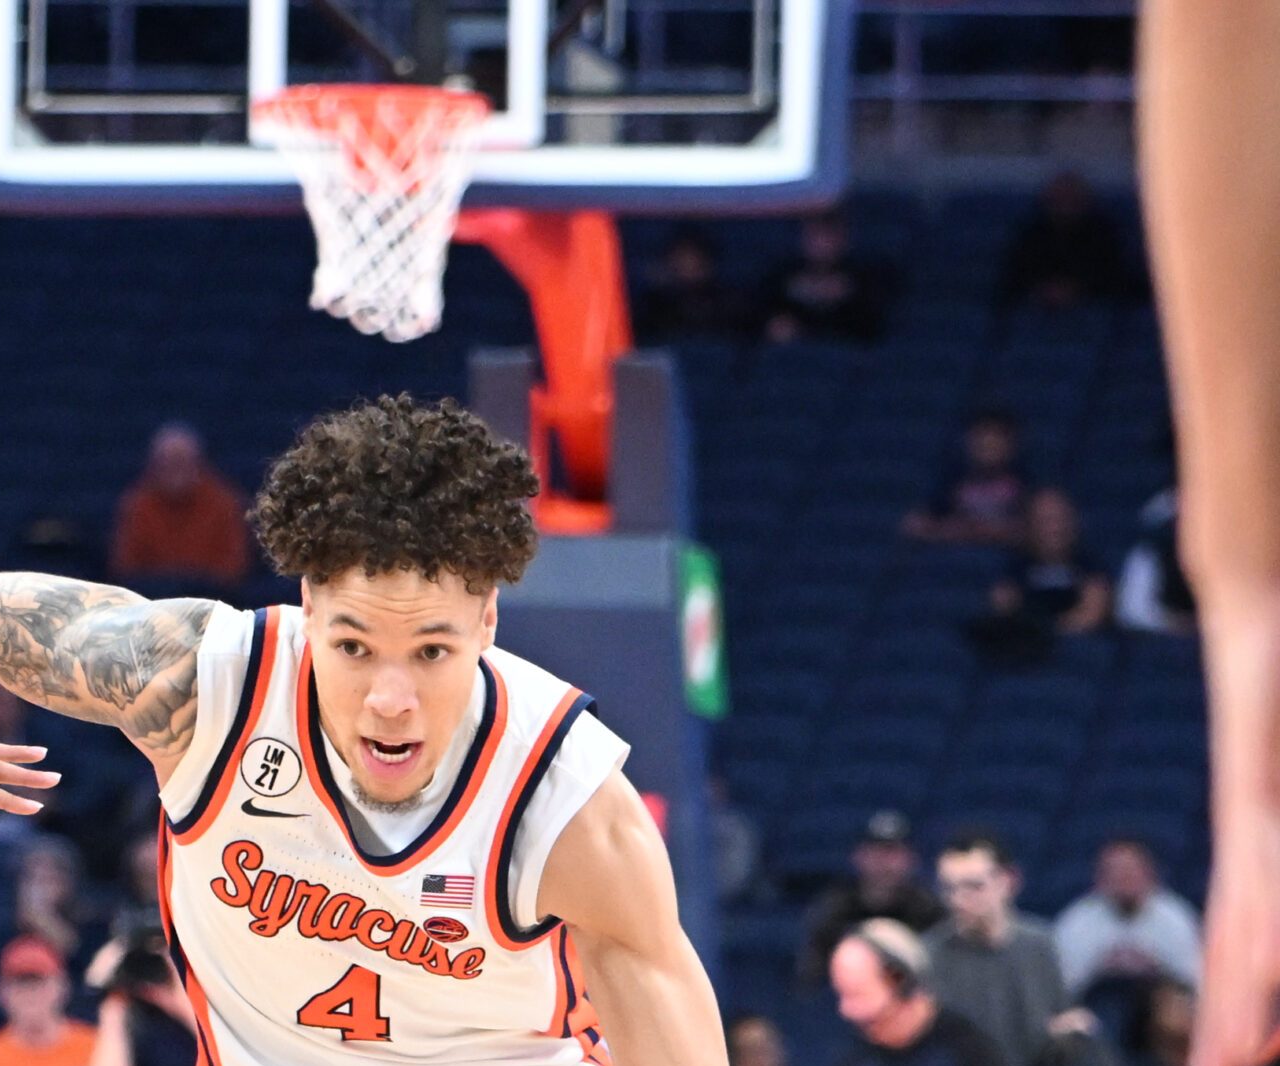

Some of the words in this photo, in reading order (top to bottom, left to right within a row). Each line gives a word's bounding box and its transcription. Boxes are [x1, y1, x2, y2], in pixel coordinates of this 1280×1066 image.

[254, 762, 280, 791] 21
[263, 744, 286, 767] LM
[210, 839, 486, 980] Syracuse
[296, 963, 393, 1042] 4
